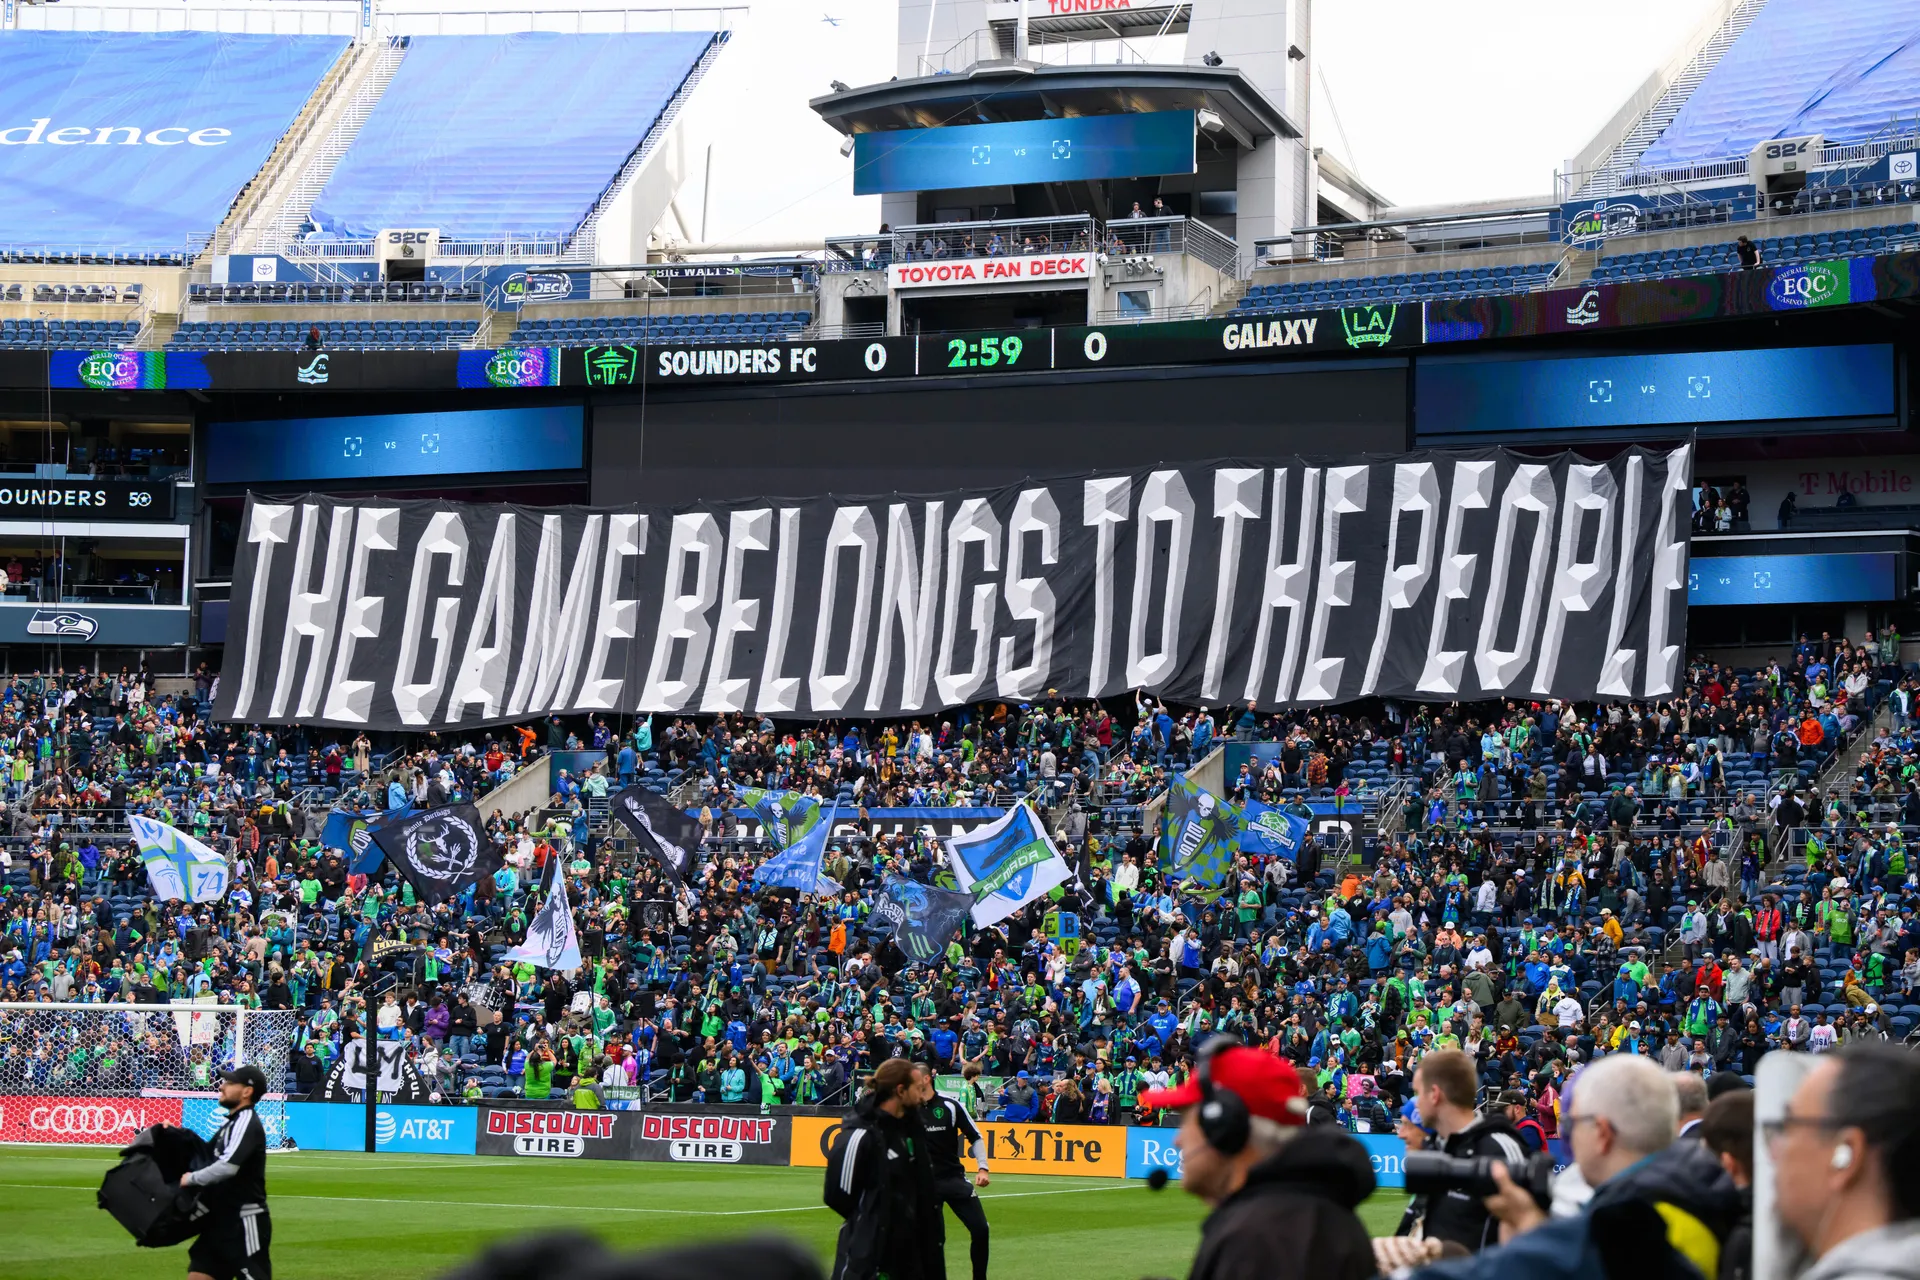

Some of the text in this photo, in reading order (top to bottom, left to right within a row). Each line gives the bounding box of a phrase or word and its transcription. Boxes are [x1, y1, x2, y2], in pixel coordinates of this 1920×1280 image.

[1574, 219, 1602, 234] FAN
[898, 257, 1086, 283] TOYOTA FAN DECK
[1783, 275, 1827, 298] EQC
[1353, 310, 1386, 332] LA
[1083, 317, 1318, 362] 0 GALAXY
[658, 342, 887, 376] SOUNDERS FC 0
[947, 335, 1023, 368] 2:59
[89, 361, 128, 381] EQC
[496, 359, 533, 379] EQC
[1641, 385, 1656, 394] VS
[384, 441, 397, 450] VS
[1827, 469, 1913, 495] Mobile
[233, 443, 1691, 725] THE GAME BELONGS TO THE PEOPLE
[400, 1118, 455, 1140] AT&T
[487, 1110, 613, 1138] DISCOUNT
[642, 1115, 772, 1143] DISCOUNT
[521, 1138, 575, 1153] TIRE
[678, 1143, 734, 1158] TIRE
[1025, 1129, 1102, 1163] Tire
